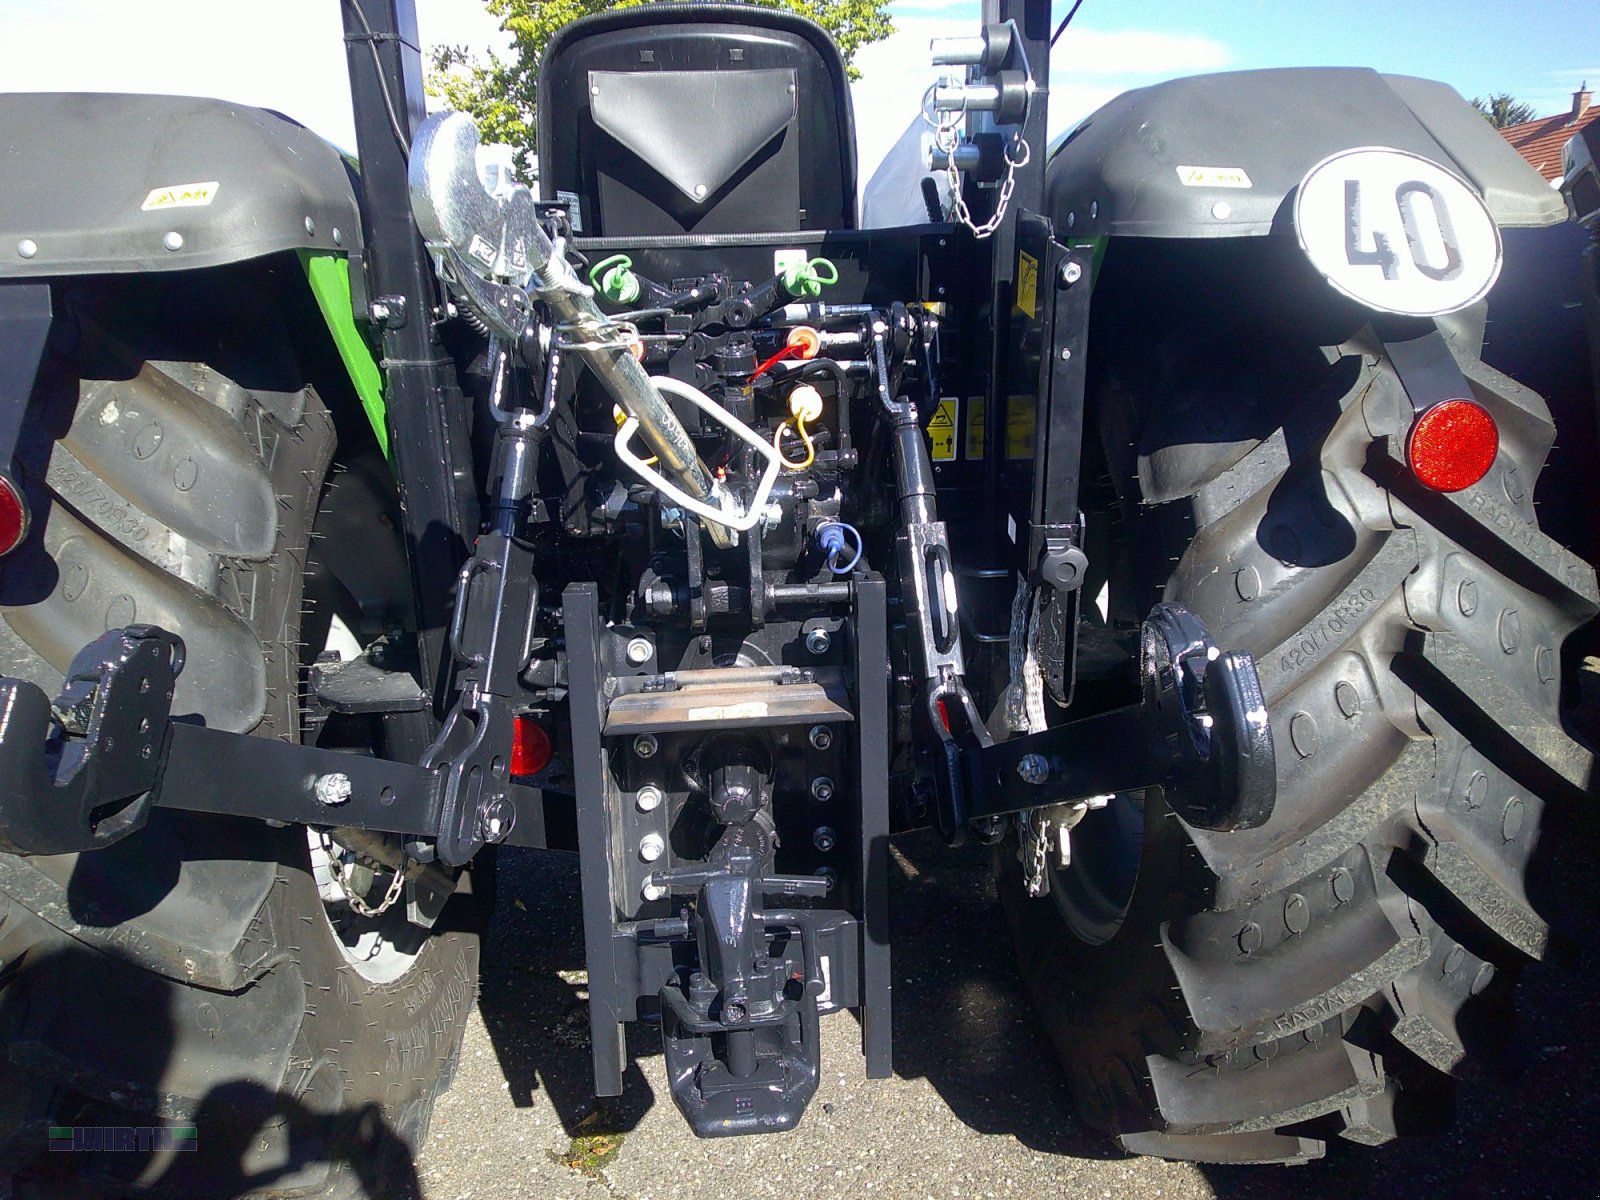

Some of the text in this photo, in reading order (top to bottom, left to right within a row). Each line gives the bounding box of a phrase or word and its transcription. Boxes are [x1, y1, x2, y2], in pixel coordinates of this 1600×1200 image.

[1343, 179, 1464, 281] 40
[55, 466, 149, 541] 420/70R30
[1280, 588, 1376, 672] 420/70R30
[1273, 990, 1354, 1033] RADIAL
